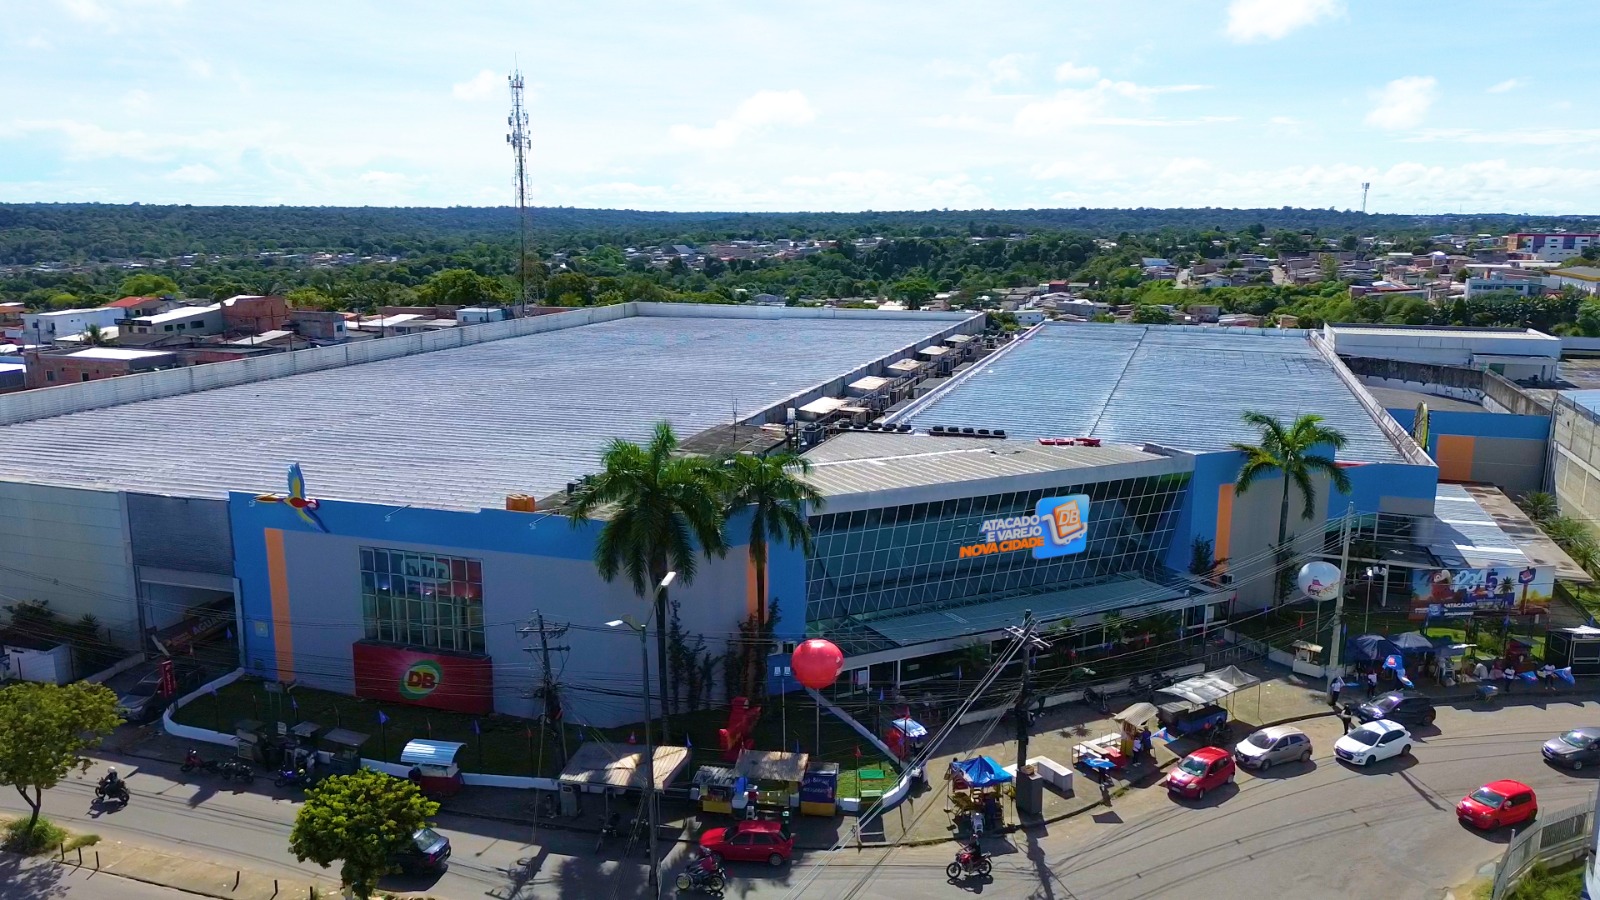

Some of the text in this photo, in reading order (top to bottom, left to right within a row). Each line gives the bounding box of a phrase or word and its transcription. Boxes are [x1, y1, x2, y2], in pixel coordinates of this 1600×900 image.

[981, 514, 1040, 532] ATACADO
[1058, 509, 1079, 526] DB
[986, 525, 1043, 543] E VAREJO
[959, 536, 1045, 559] NOVA CIDADE
[407, 670, 436, 689] DB
